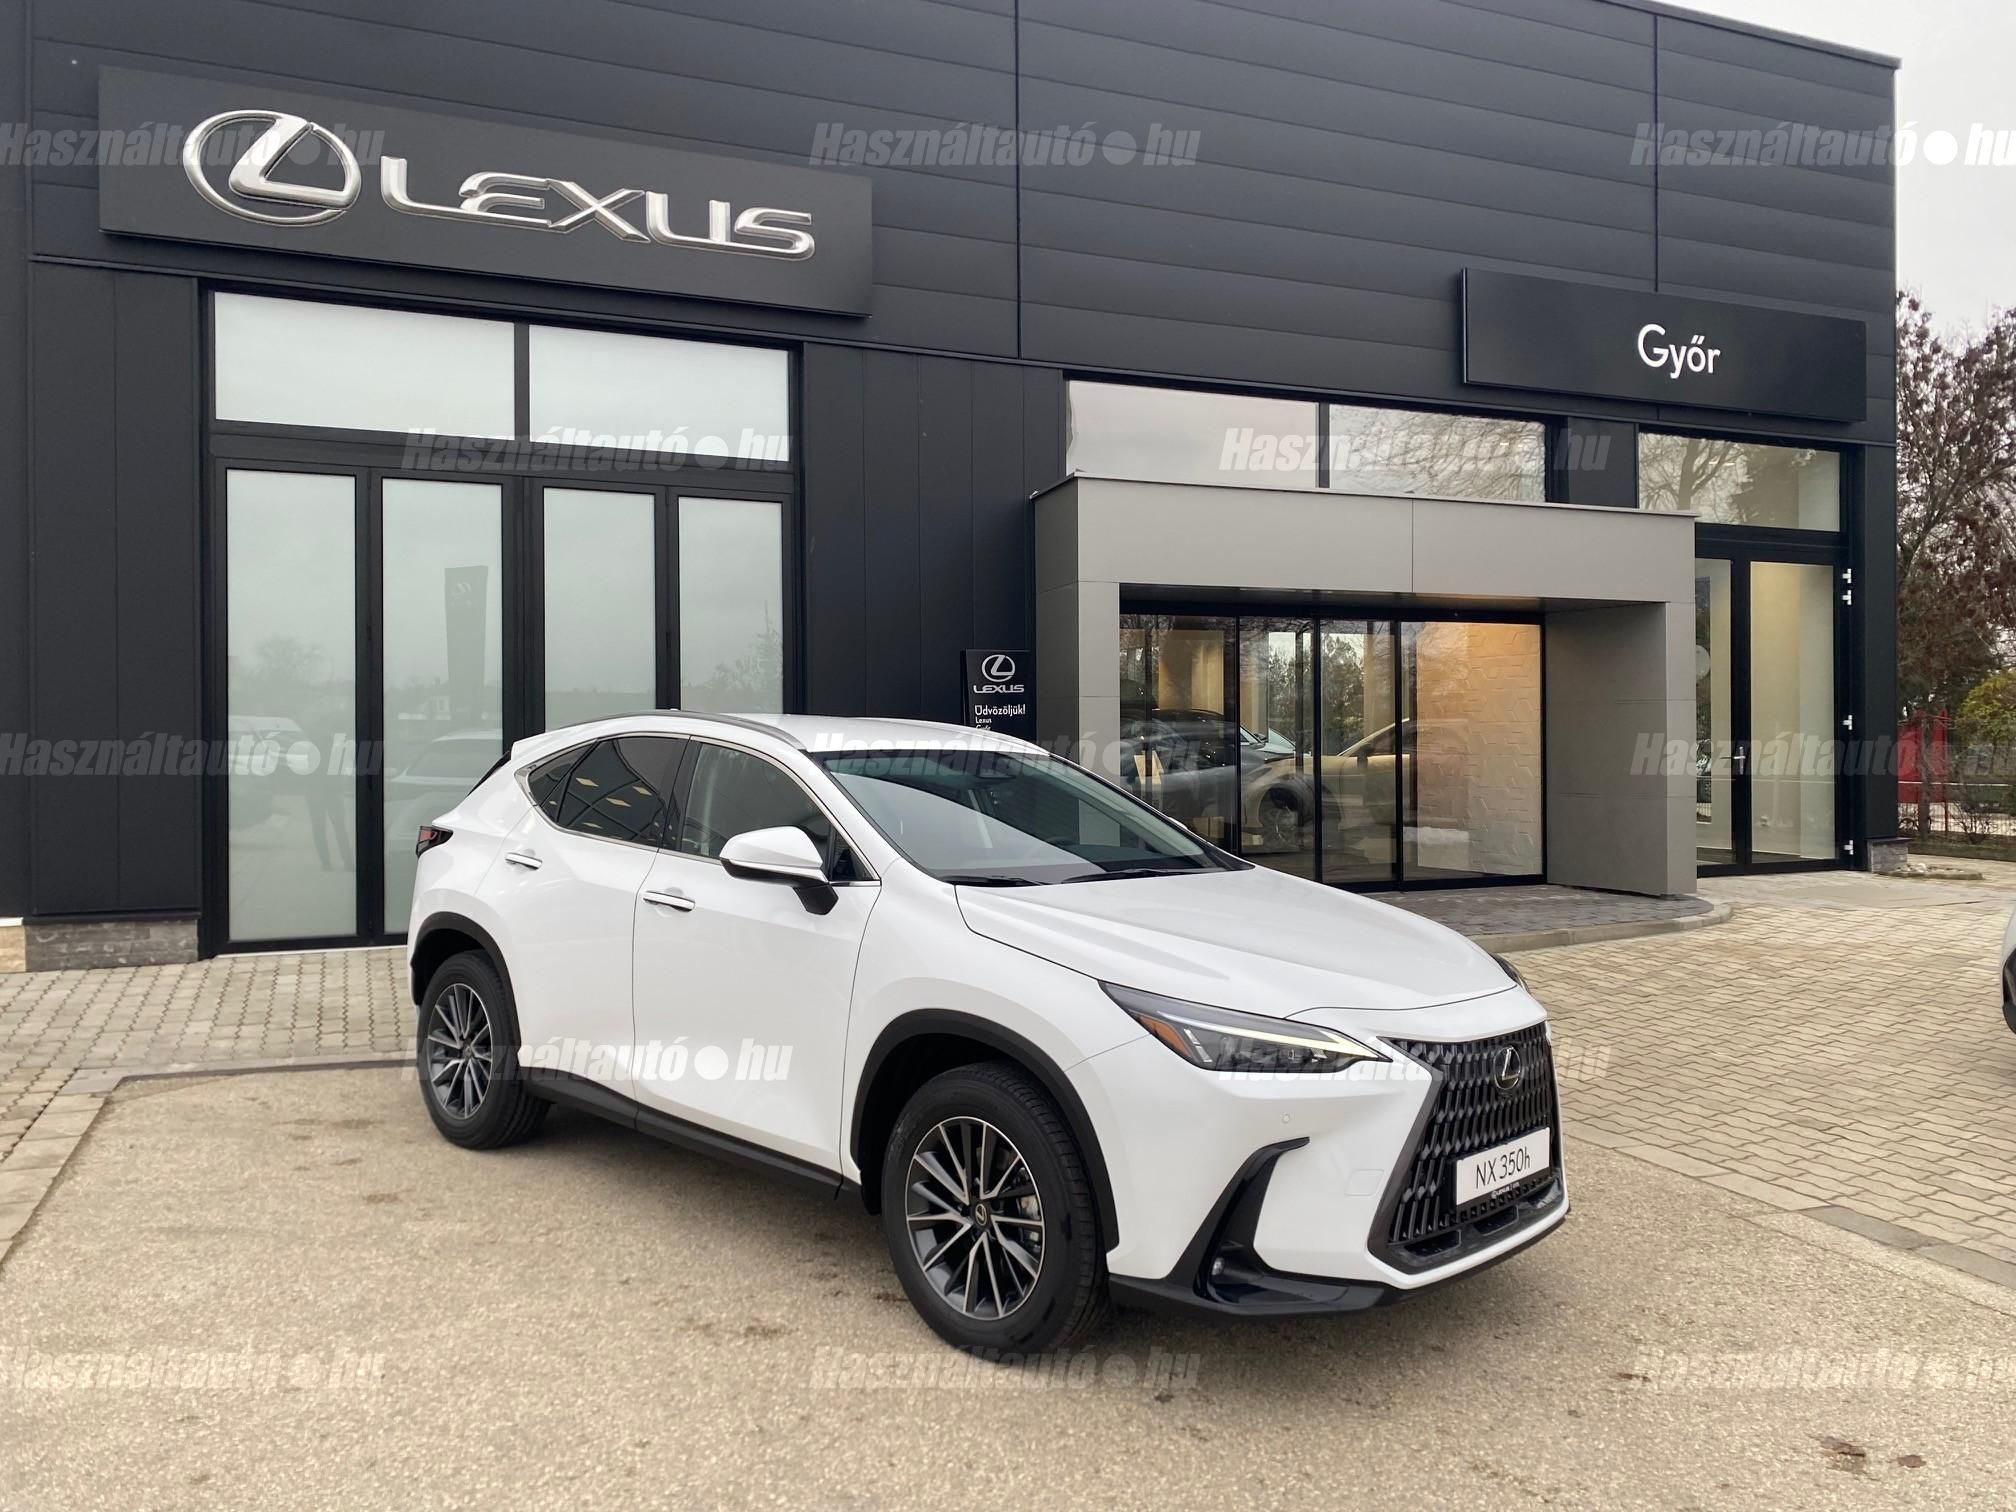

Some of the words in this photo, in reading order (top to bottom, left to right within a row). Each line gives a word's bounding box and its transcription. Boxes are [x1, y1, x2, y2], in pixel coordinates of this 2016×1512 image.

[380, 155, 816, 262] LEXUS
[1637, 323, 1721, 379] Győr
[973, 684, 1025, 694] LEXUS
[1476, 1157, 1497, 1189] NX
[1499, 1146, 1531, 1179] 350h
